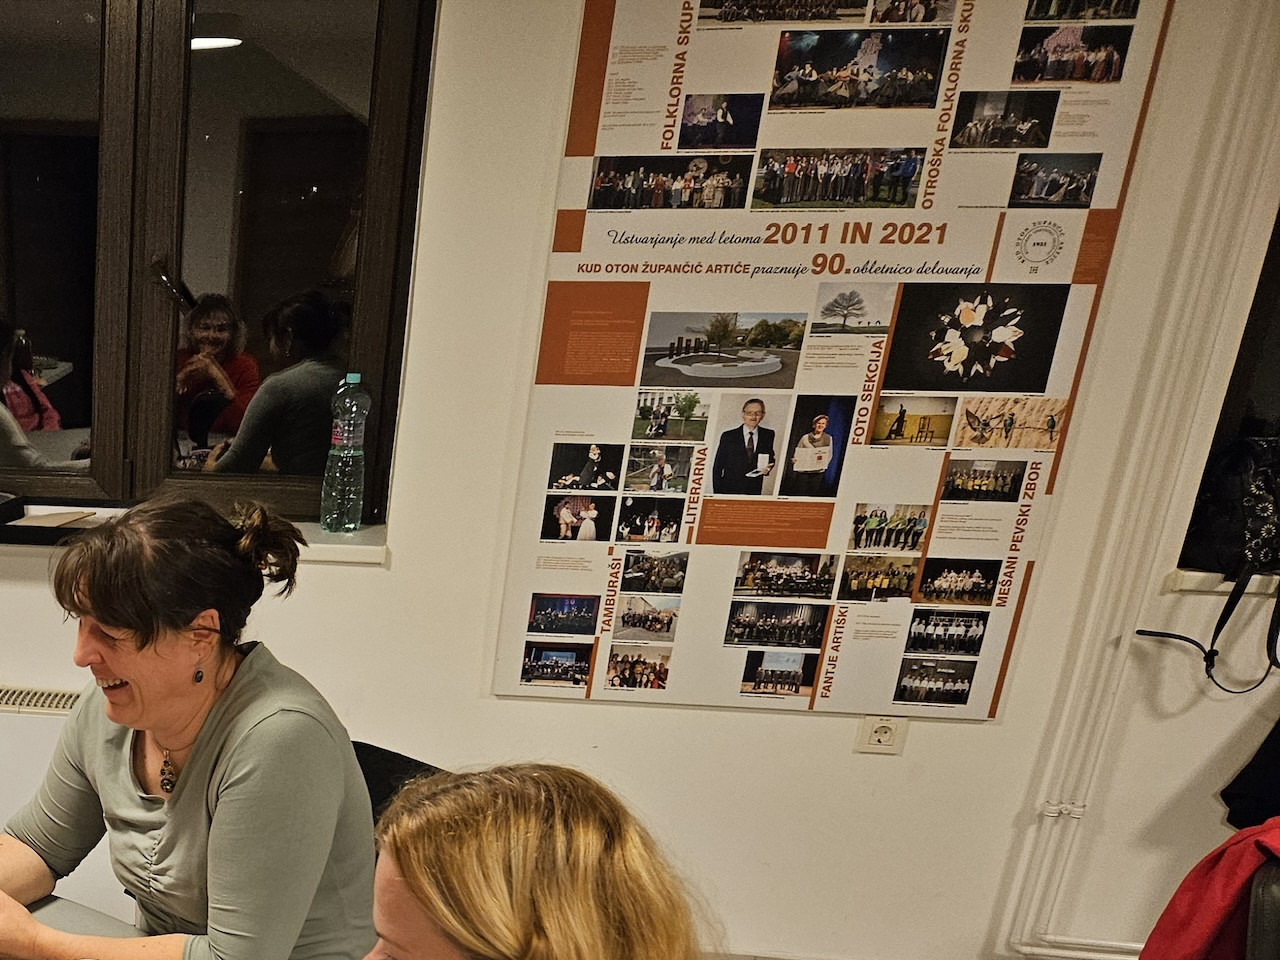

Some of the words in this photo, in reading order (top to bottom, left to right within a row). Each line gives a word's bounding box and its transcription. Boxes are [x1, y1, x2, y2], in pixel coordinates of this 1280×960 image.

[661, 51, 687, 150] FOLKLORNA
[922, 136, 946, 210] OTROŠKA
[937, 38, 967, 132] FOLKLORNA
[958, 0, 975, 33] SKU
[577, 263, 601, 273] KUD
[605, 263, 638, 273] OTON
[705, 261, 751, 273] ARTIČE
[750, 263, 809, 278] praznuje
[811, 253, 851, 275] 90.
[852, 260, 915, 275] obletnico
[916, 260, 982, 278] delovanja
[607, 229, 687, 248] Ustvarjanje
[688, 231, 716, 244] med
[718, 231, 763, 244] letoma
[763, 222, 829, 244] 2011
[840, 222, 873, 244] IN
[879, 222, 948, 244] 2021
[851, 406, 869, 445] FOTO
[861, 339, 884, 402] SEKCIJA
[685, 447, 708, 525] LITERARNA
[995, 556, 1019, 607] MEŠANI
[1009, 504, 1032, 552] PEVSKI
[1022, 461, 1042, 500] ZBOR
[601, 558, 622, 634] TAMBURAŠI
[820, 655, 838, 698] FANTJE
[830, 606, 849, 653] ARTIŠKI
